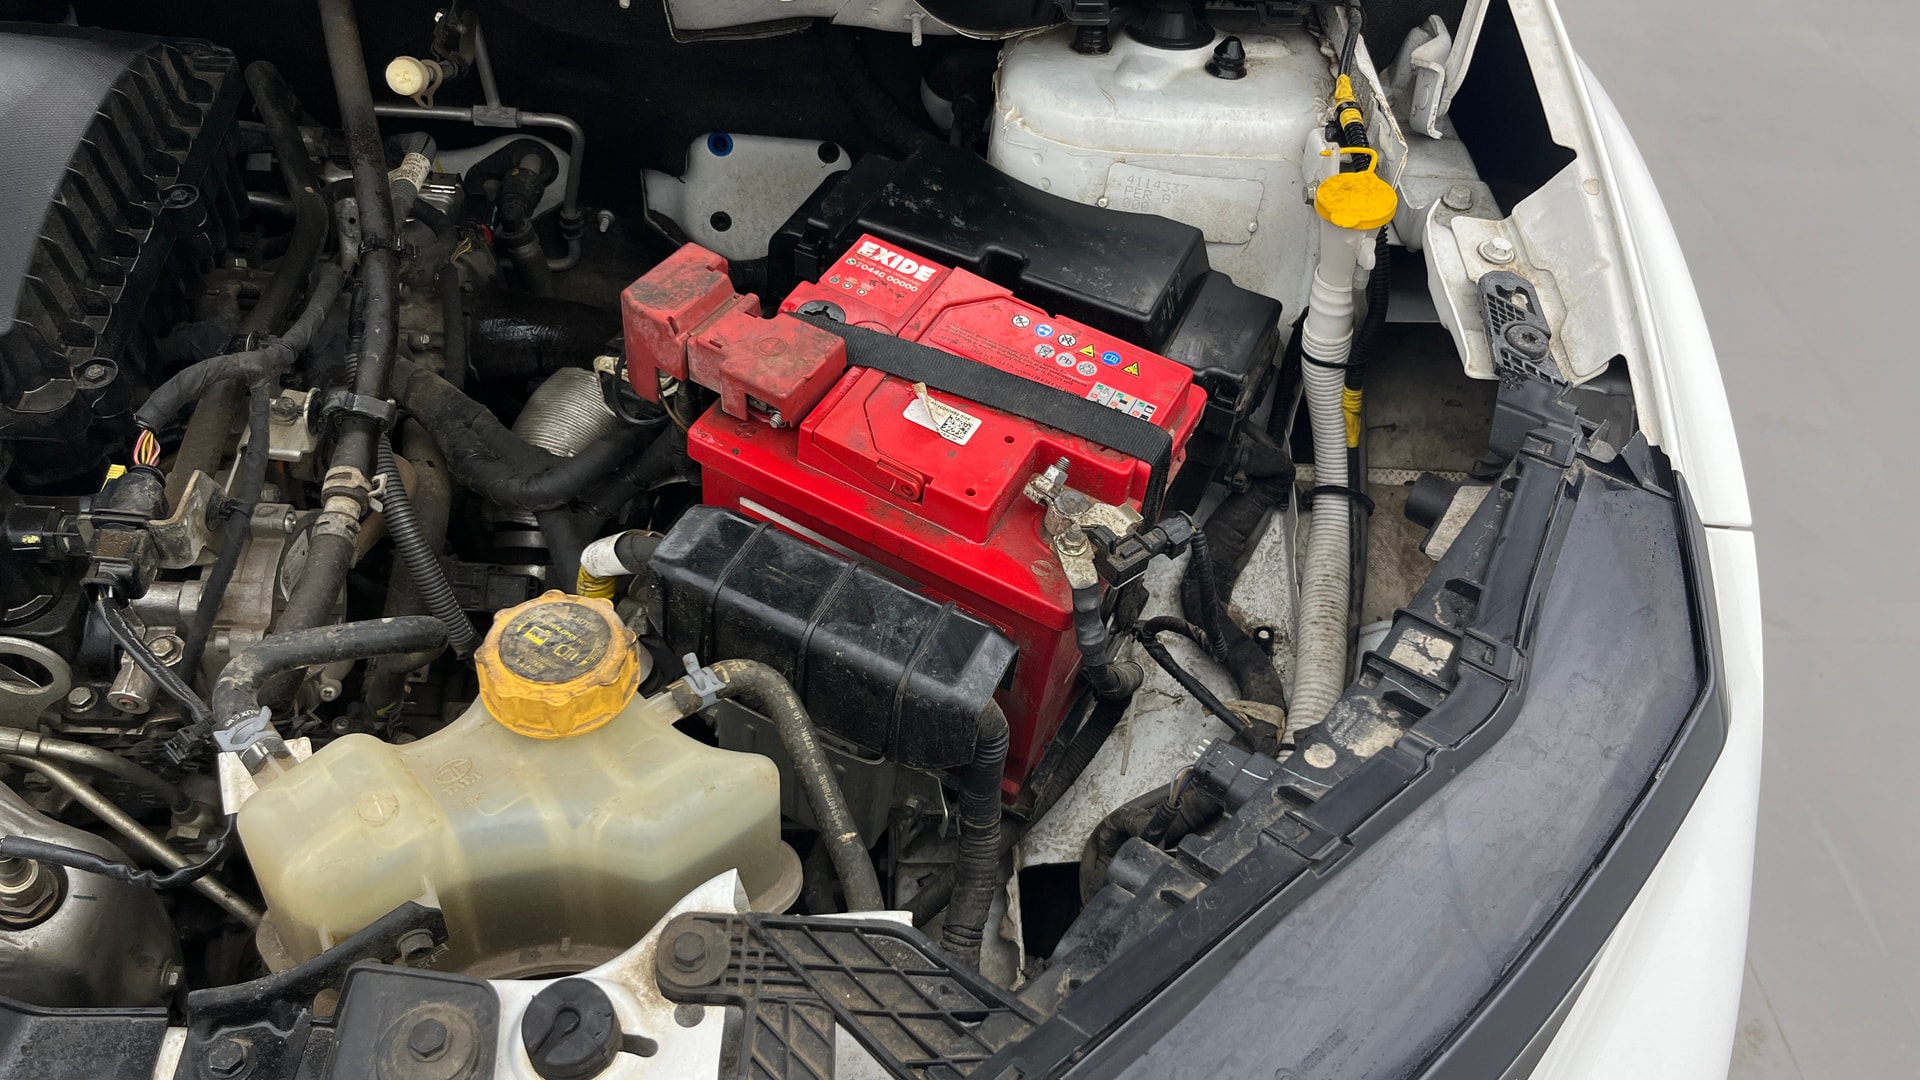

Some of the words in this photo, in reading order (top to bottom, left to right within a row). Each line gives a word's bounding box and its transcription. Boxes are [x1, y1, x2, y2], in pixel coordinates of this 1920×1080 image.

[1124, 186, 1152, 200] PER
[1127, 175, 1190, 194] 4114337
[857, 240, 937, 282] EXIDE
[886, 275, 919, 293] 00000
[1059, 355, 1072, 365] Pb
